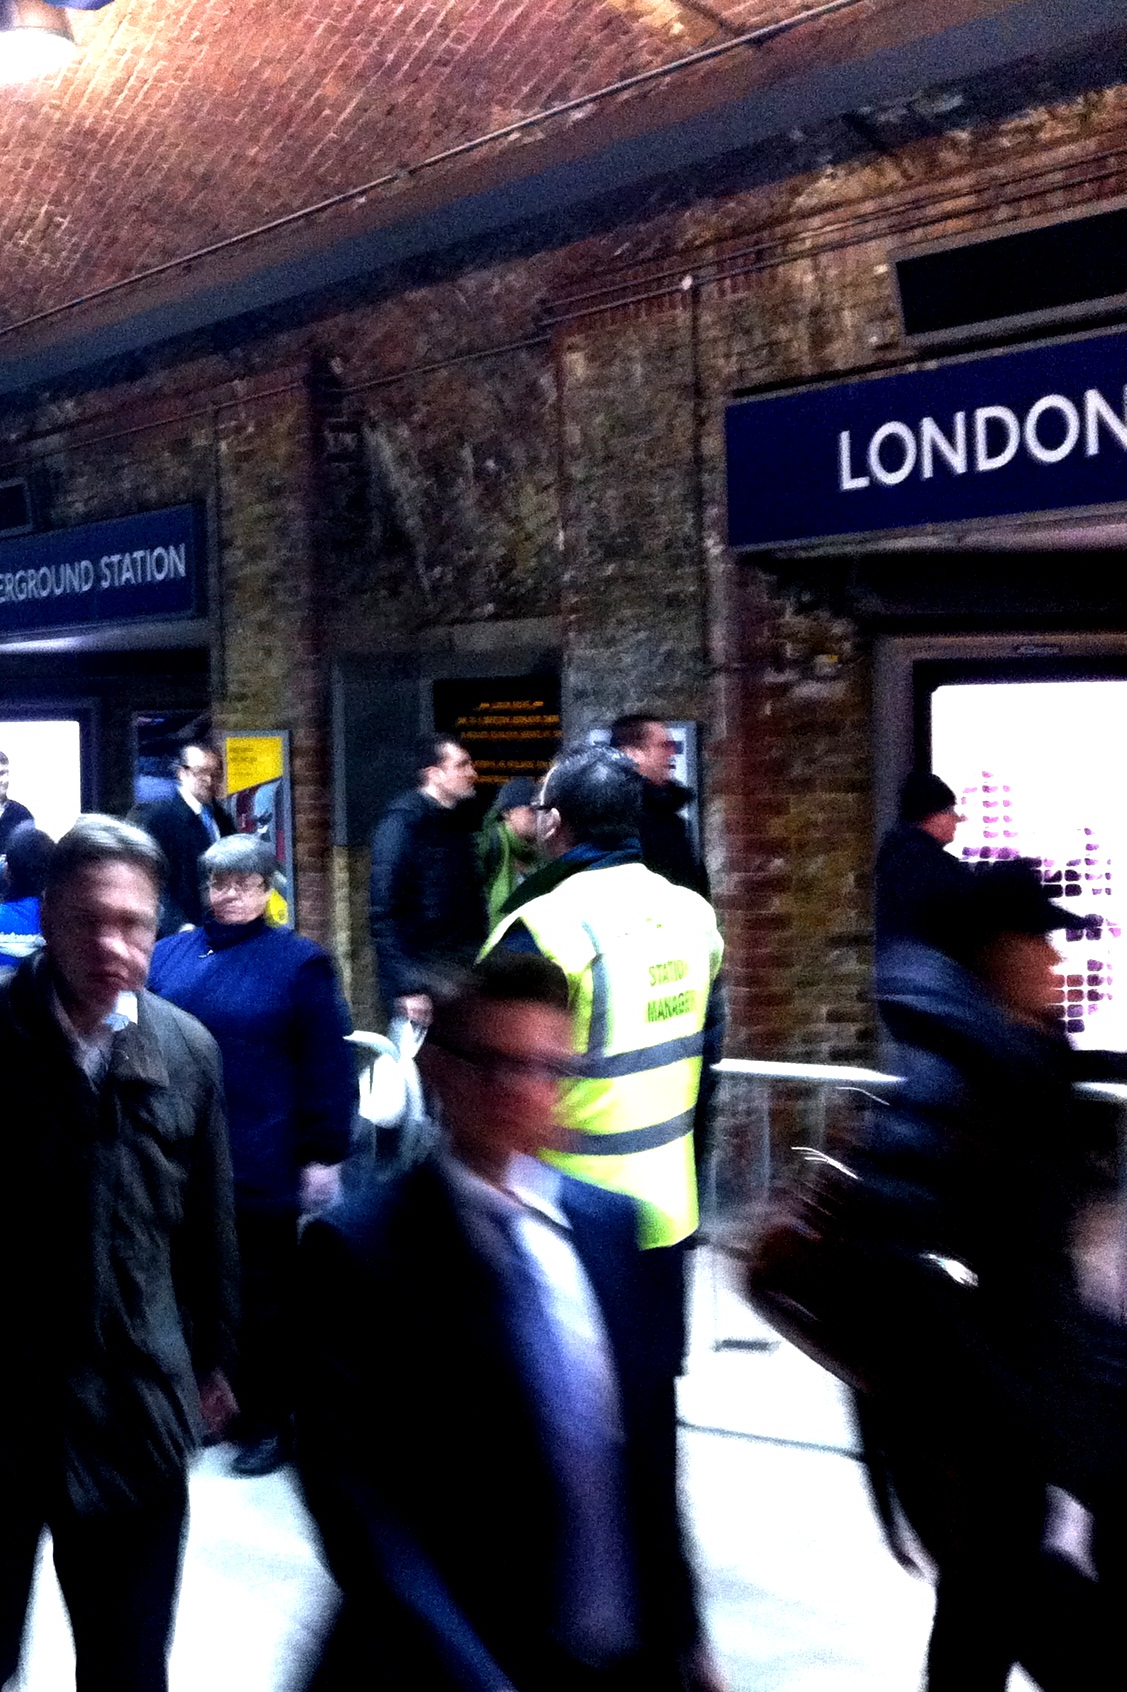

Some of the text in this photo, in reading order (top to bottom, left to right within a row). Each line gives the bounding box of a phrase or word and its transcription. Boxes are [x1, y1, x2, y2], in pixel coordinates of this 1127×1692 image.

[839, 384, 1127, 491] LONDON
[100, 543, 186, 589] STATION
[648, 960, 689, 987] STATIO
